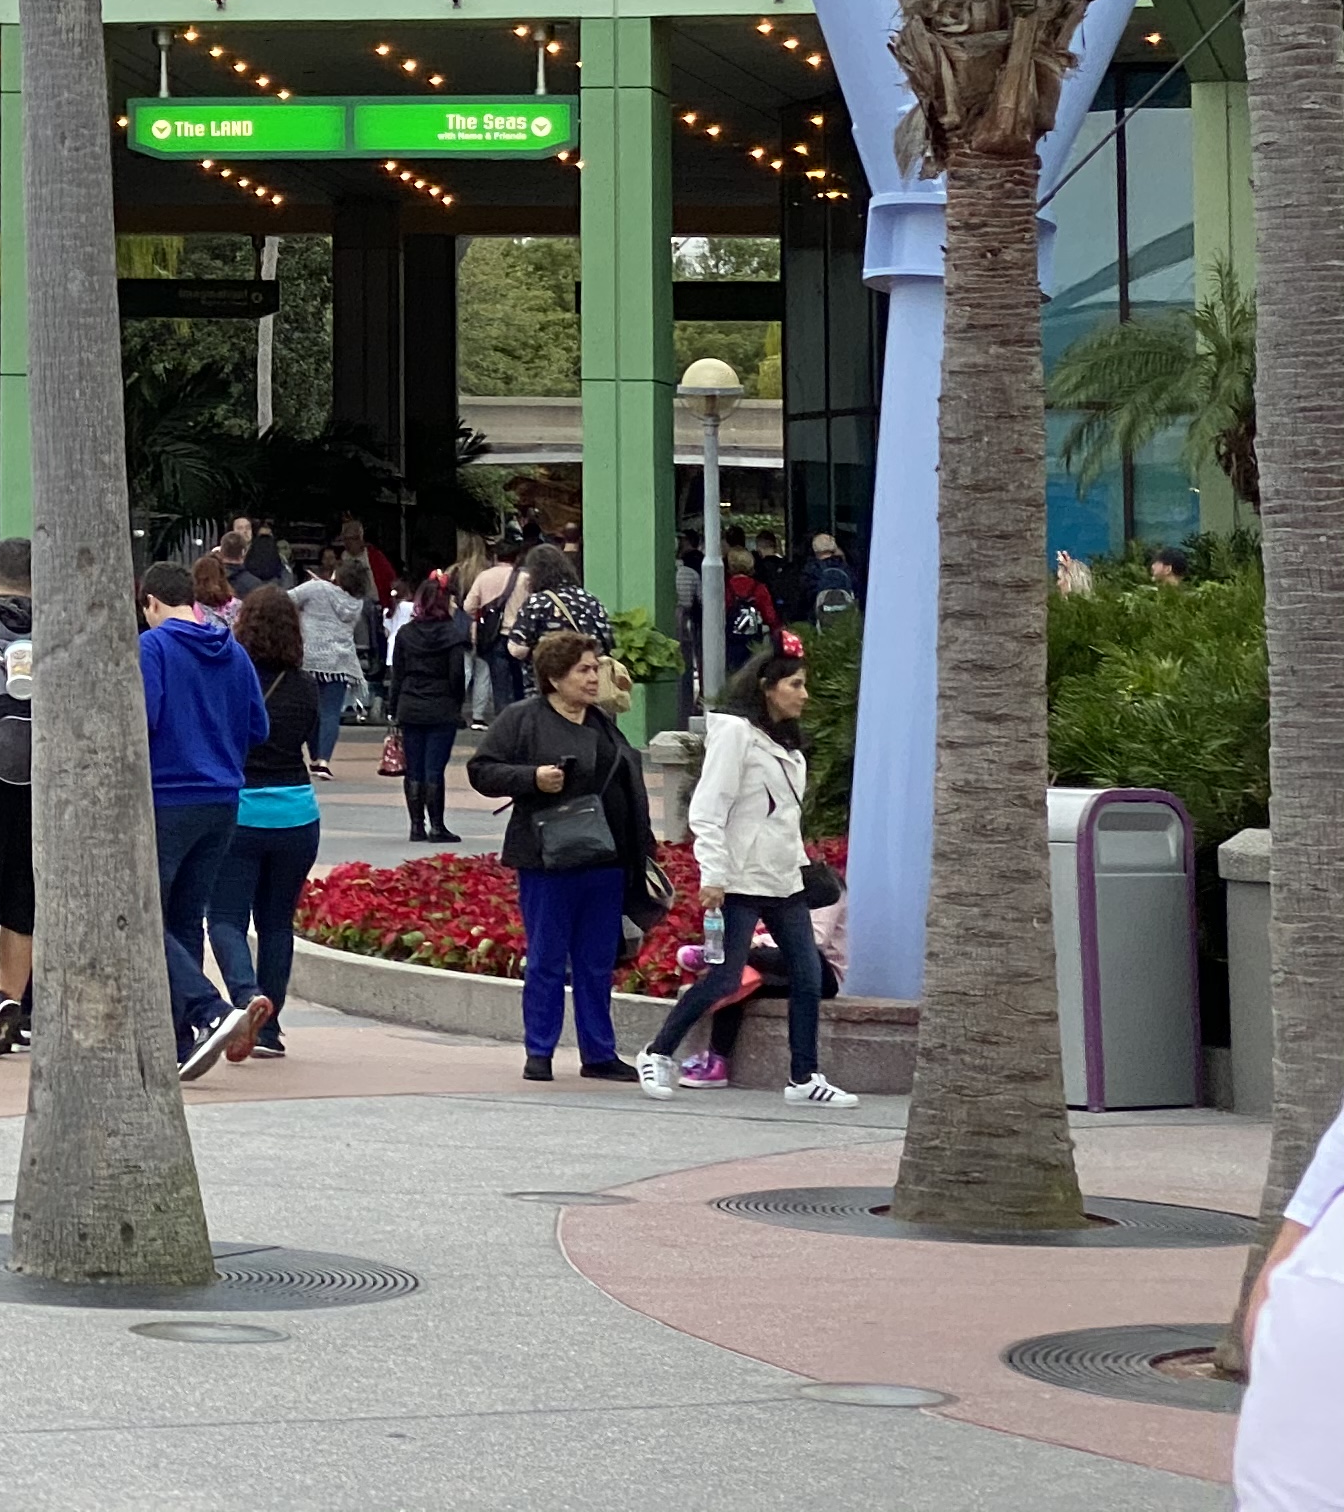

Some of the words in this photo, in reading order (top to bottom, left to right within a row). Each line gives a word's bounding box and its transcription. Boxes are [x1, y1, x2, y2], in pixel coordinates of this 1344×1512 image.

[173, 120, 206, 138] The
[210, 120, 253, 137] LAND
[445, 113, 478, 130] The
[482, 113, 528, 130] Seas
